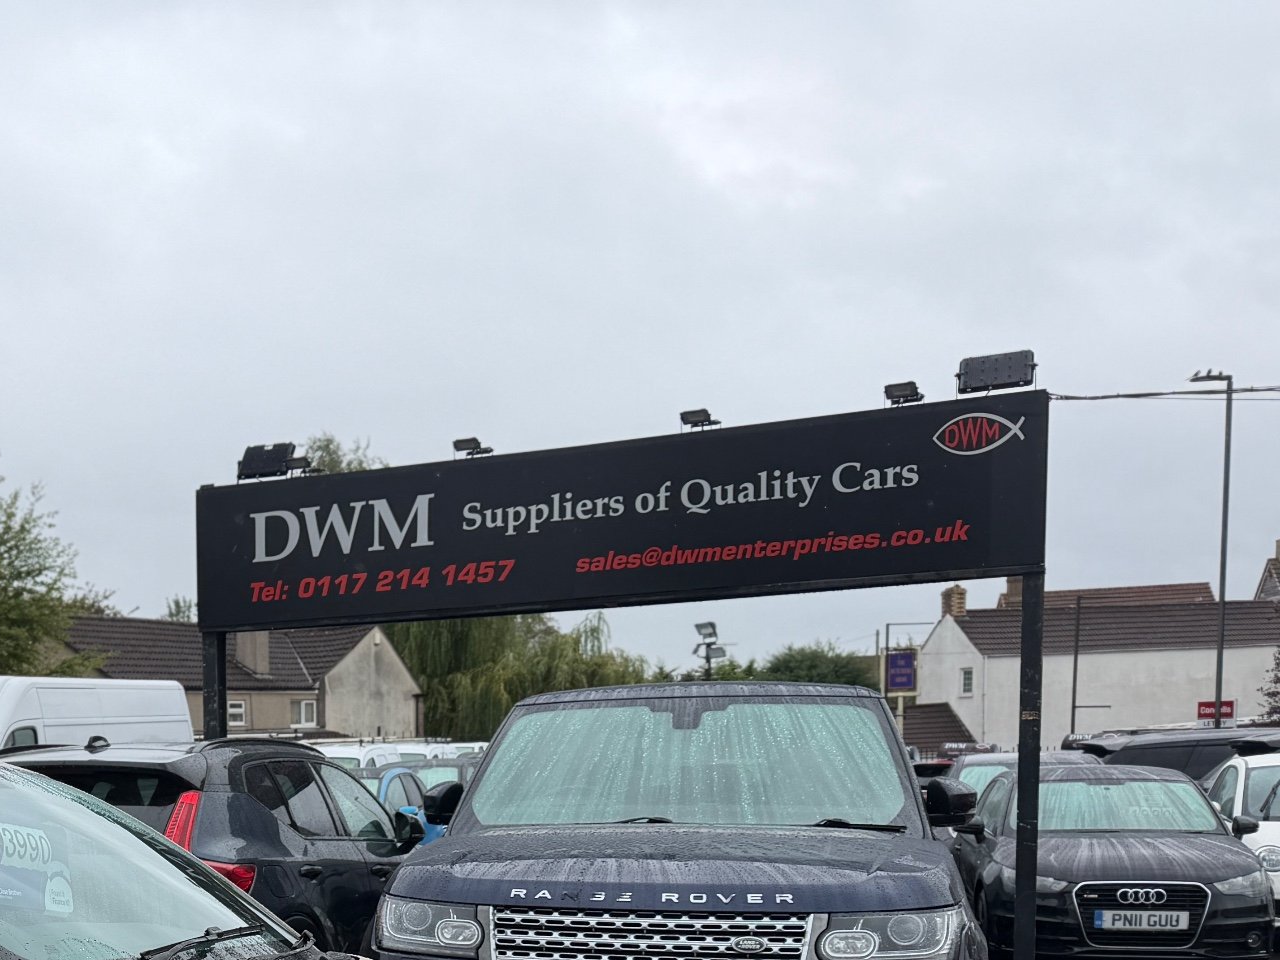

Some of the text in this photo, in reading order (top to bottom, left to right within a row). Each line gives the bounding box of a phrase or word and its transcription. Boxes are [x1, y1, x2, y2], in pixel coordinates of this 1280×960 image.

[944, 417, 1000, 450] DWM
[250, 462, 920, 563] DWM Suppliers of Quality Cars
[575, 519, 971, 573] sales@dwmenterprises.co.uk
[250, 559, 516, 603] Tel: 0117 214 1457
[661, 892, 795, 905] ROVER
